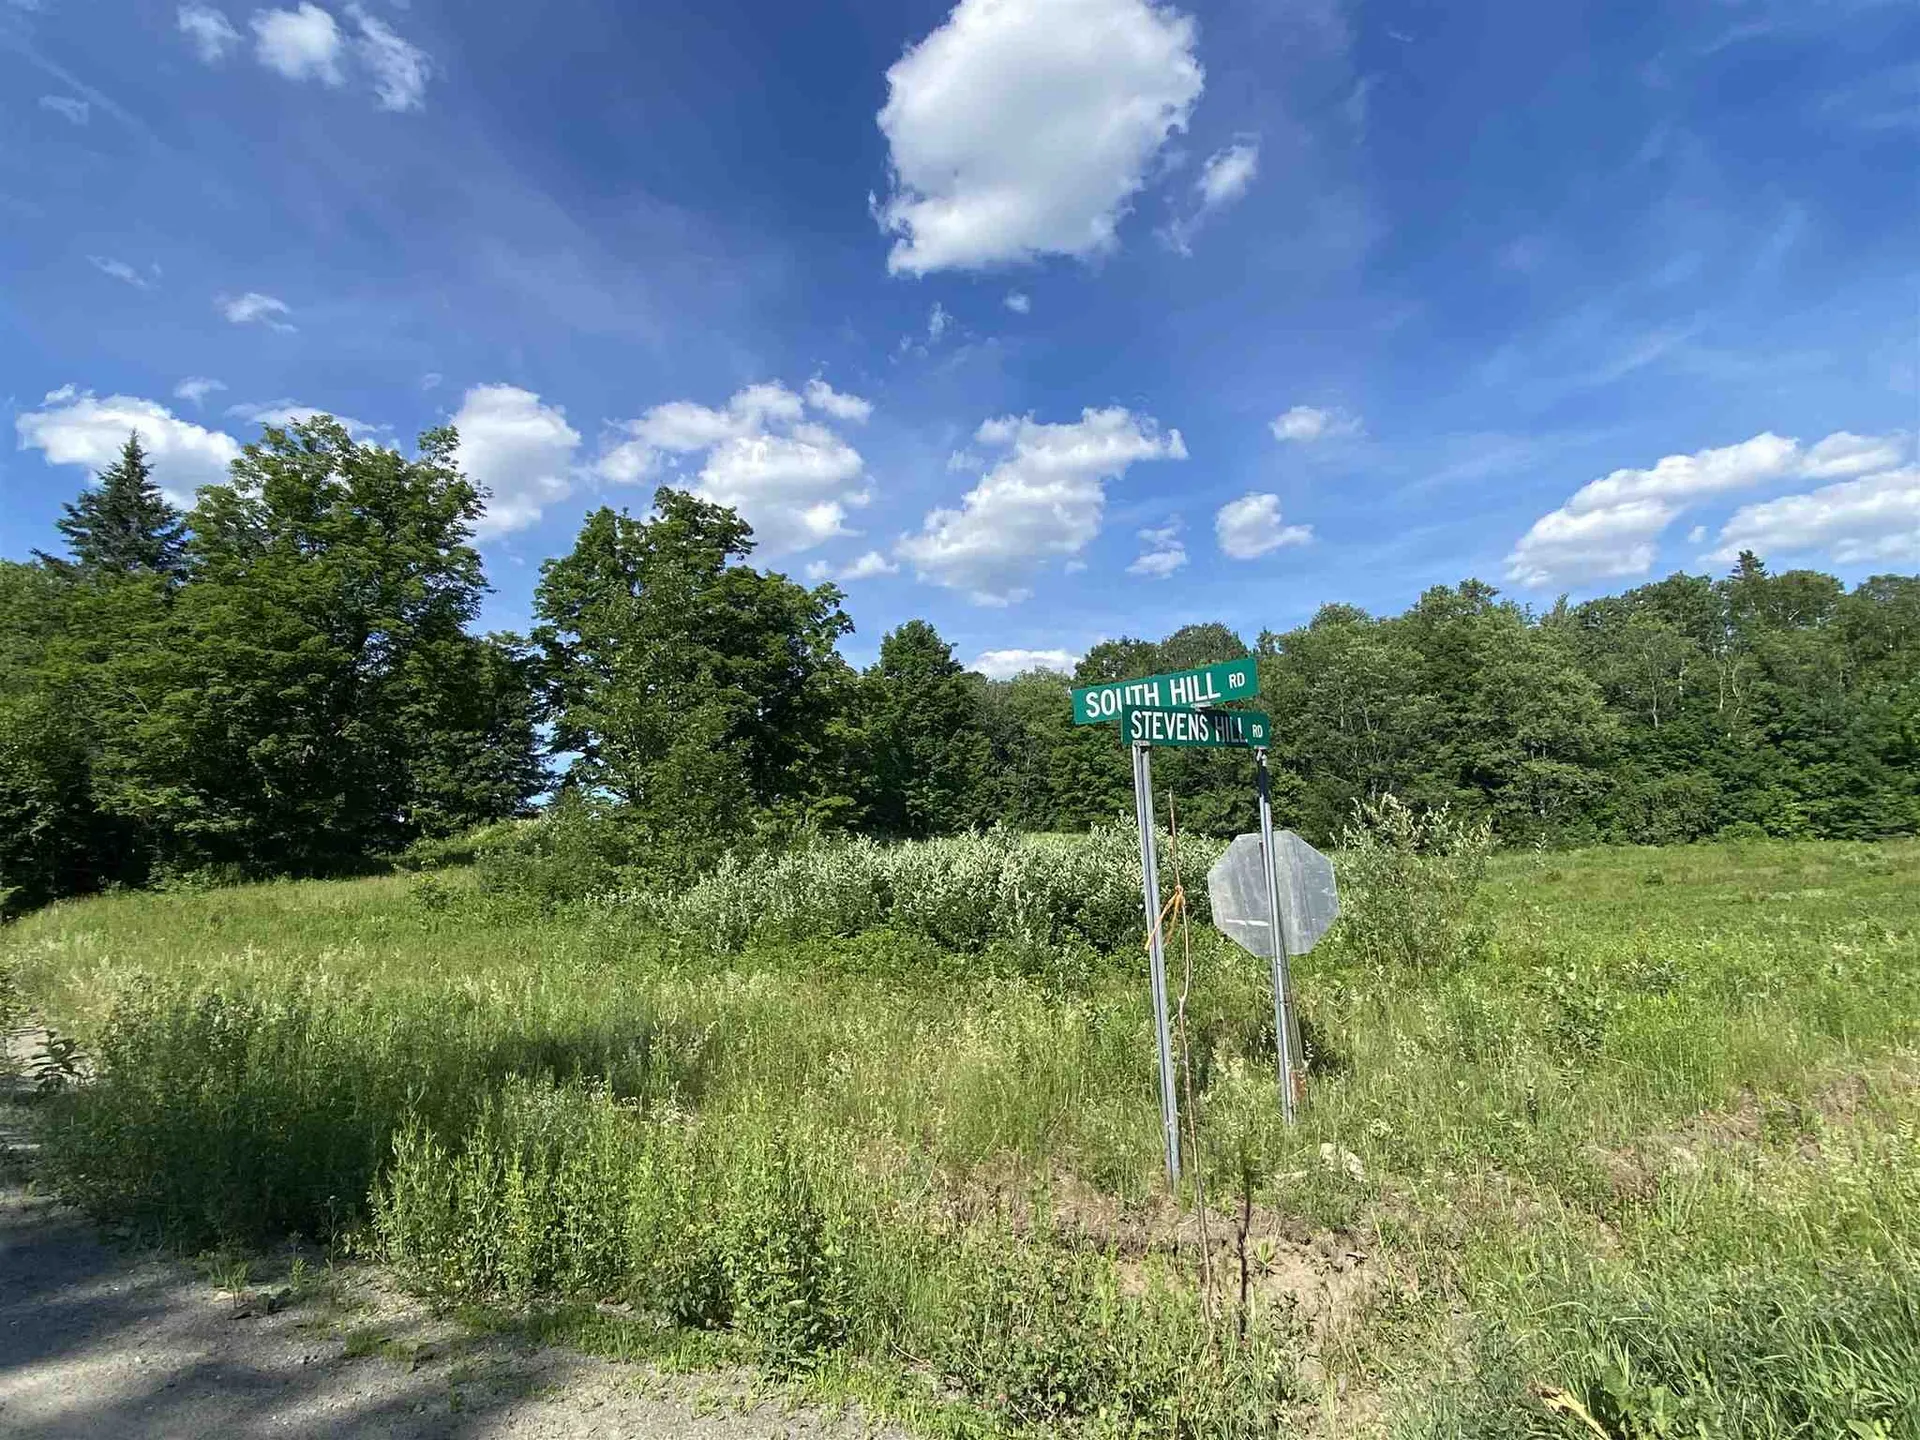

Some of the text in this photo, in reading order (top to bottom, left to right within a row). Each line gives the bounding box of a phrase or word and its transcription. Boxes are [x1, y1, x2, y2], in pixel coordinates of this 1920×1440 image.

[1085, 672, 1246, 718] SOUTH HILL RD
[1130, 710, 1264, 744] STEVENS HILL RD
